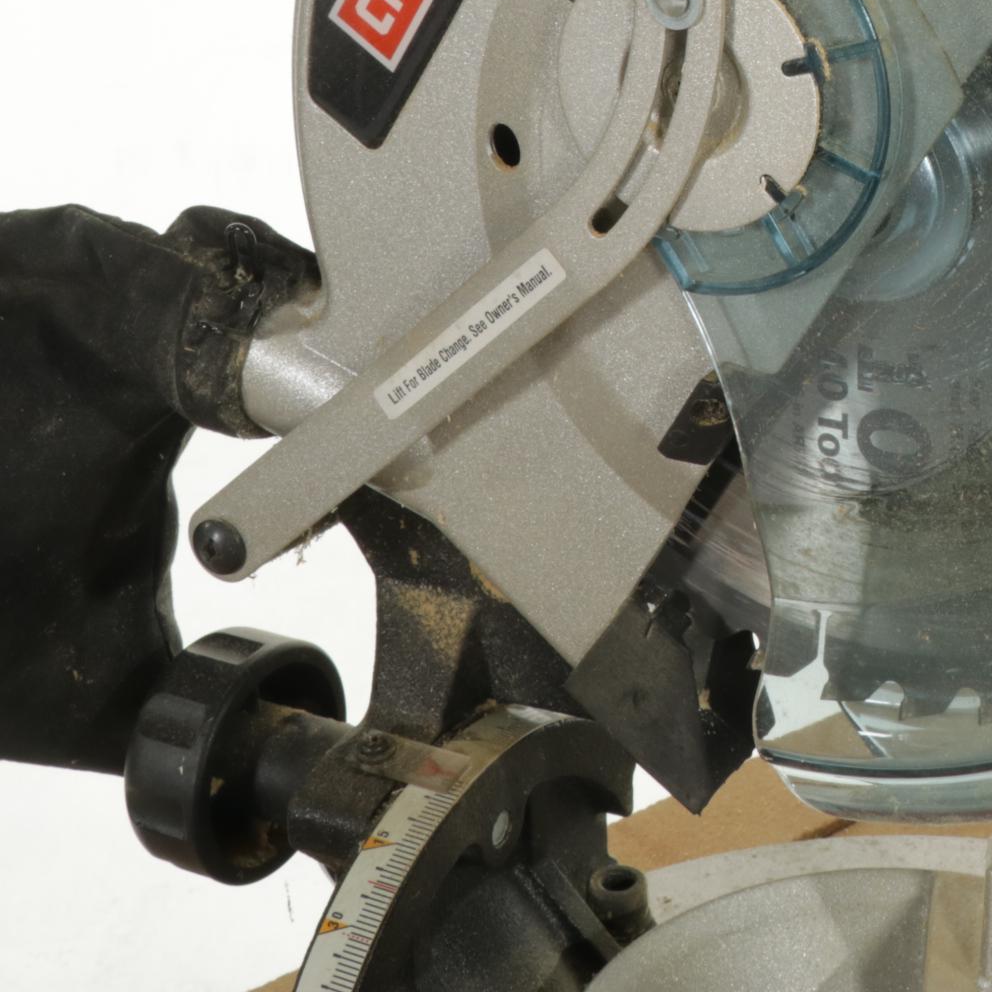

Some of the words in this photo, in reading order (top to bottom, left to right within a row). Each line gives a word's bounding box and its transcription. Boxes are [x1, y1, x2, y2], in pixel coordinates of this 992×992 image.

[387, 382, 406, 405] Lift
[403, 375, 420, 393] For
[416, 356, 441, 381] Blade
[438, 333, 472, 363] Change.
[468, 319, 488, 339] See
[485, 293, 520, 324] Owner's
[516, 265, 553, 298] Manual.
[373, 830, 390, 844] 15
[328, 912, 344, 930] 30
